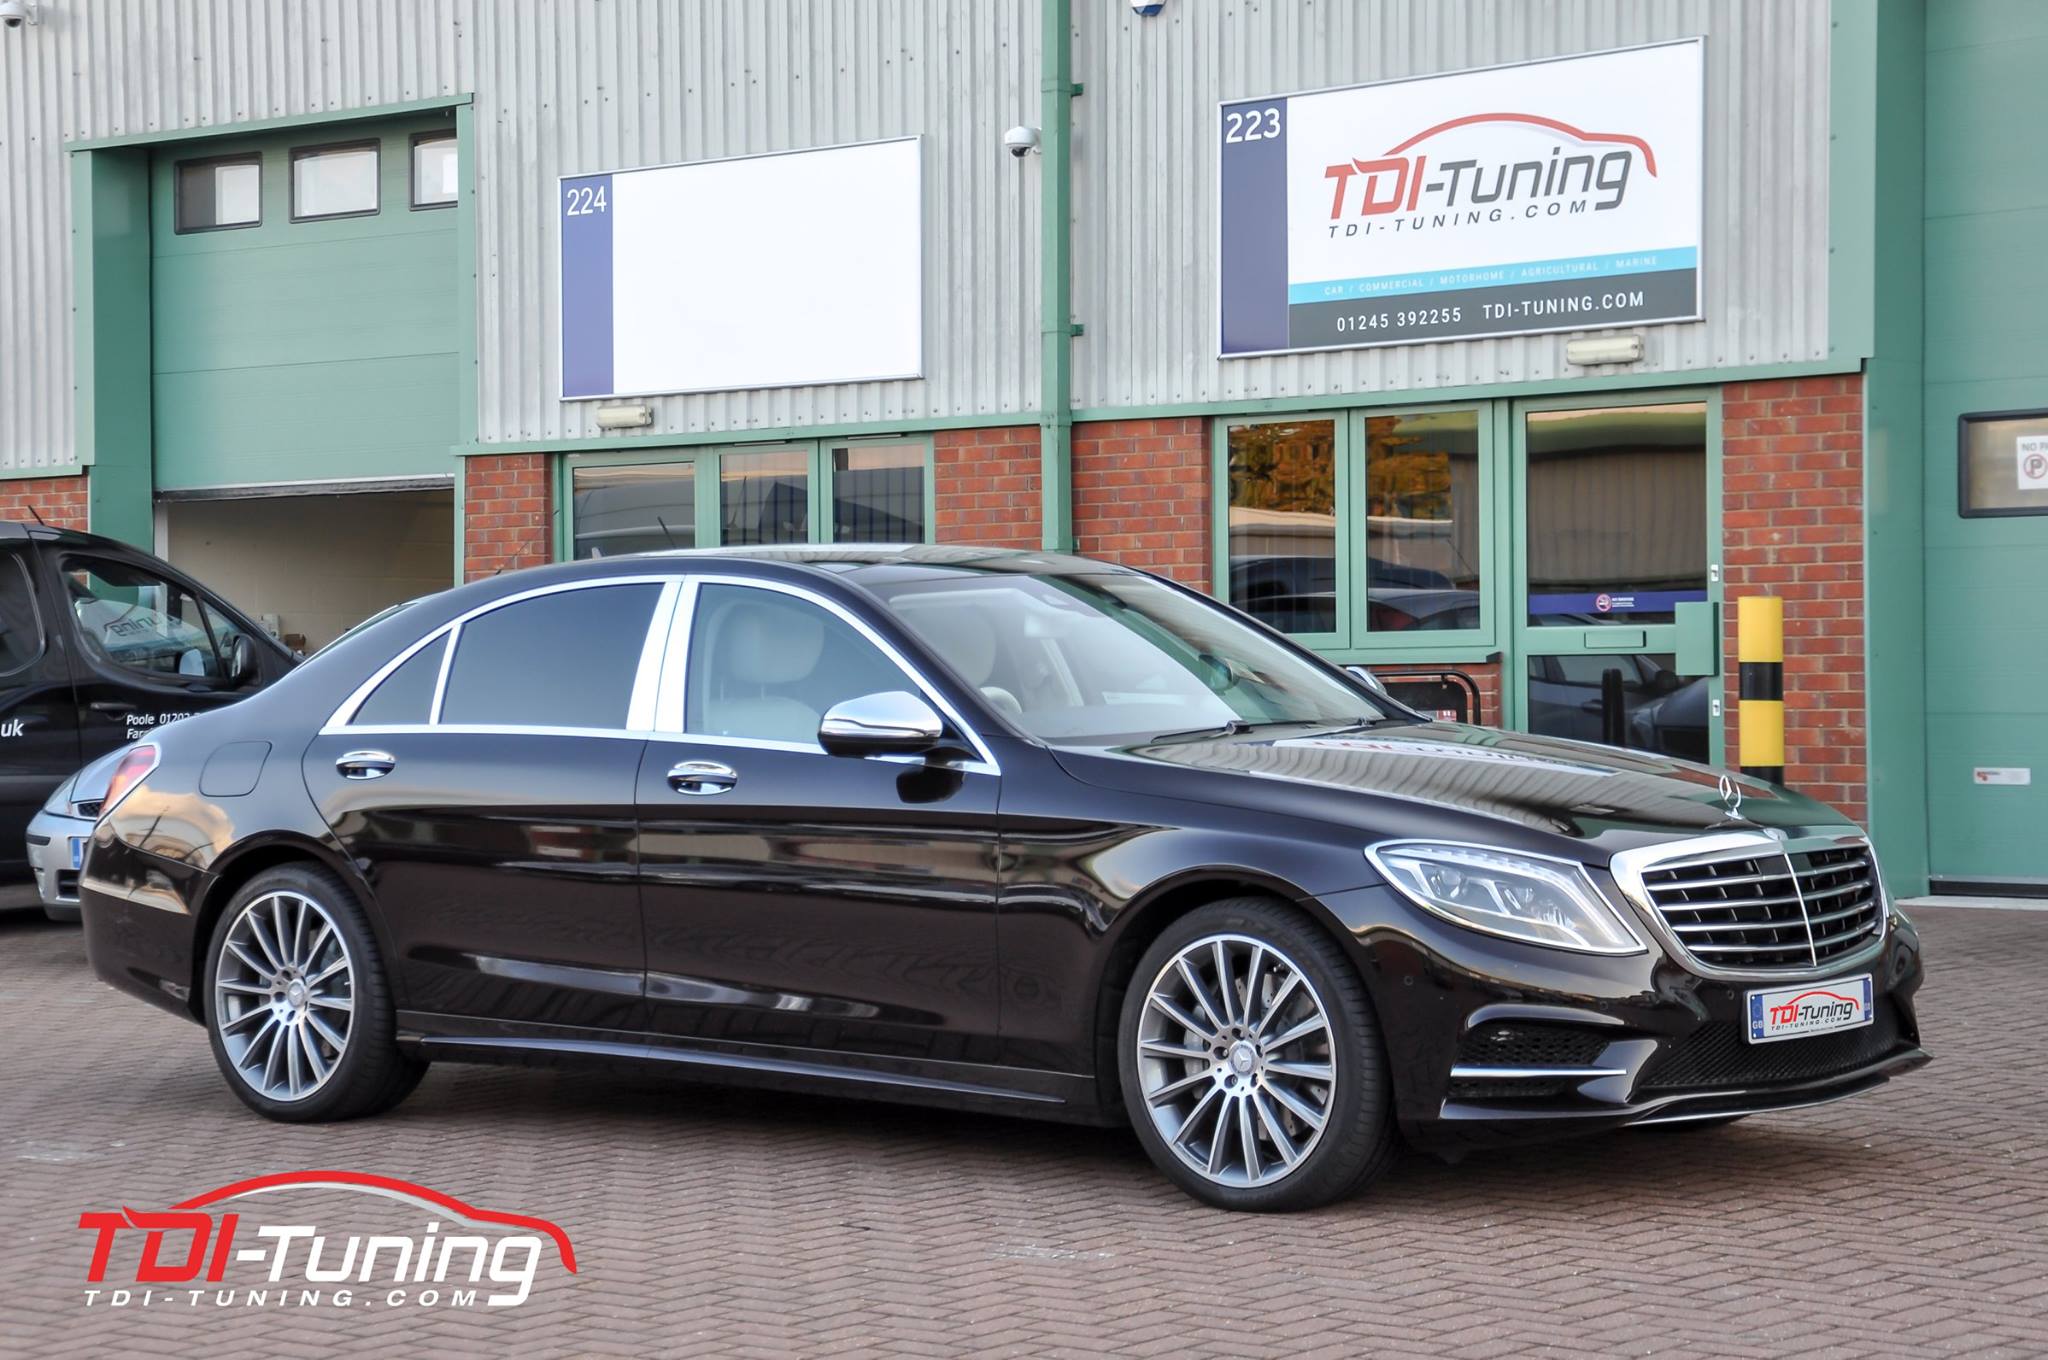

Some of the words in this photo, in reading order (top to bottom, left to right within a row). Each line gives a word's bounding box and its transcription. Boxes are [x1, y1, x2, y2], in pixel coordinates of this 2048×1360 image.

[1226, 108, 1281, 143] 223
[567, 185, 607, 216] 224
[1328, 199, 1587, 239] TDI-TUNING.COM
[1324, 286, 1345, 296] CAR
[1358, 276, 1424, 293] COMMERCIAL
[1439, 270, 1505, 285] MOTORHOME
[1520, 262, 1599, 278] AGRICULTURAL
[1615, 256, 1657, 268] MARINE
[1336, 312, 1389, 332] 01245
[1396, 307, 1462, 328] 392255
[1482, 291, 1645, 320] TDI-TUNING.COM
[2022, 442, 2037, 451] NO
[0, 719, 24, 737] uk
[126, 714, 155, 726] Poole
[1770, 1001, 1853, 1025] TDI-Tuning
